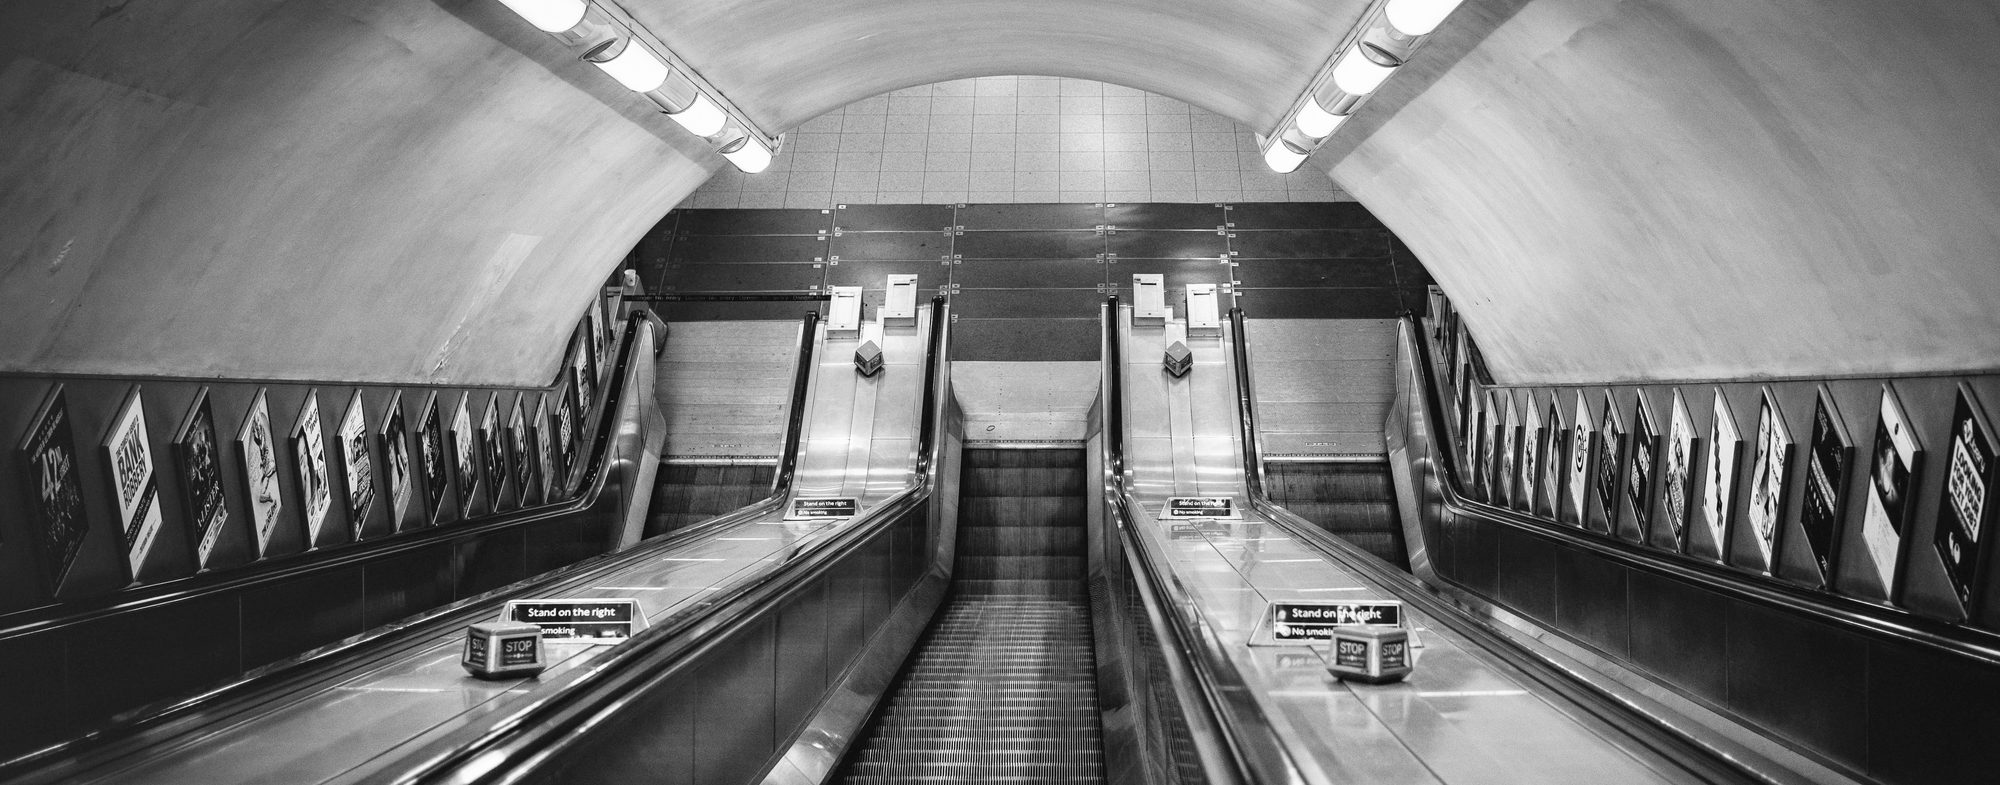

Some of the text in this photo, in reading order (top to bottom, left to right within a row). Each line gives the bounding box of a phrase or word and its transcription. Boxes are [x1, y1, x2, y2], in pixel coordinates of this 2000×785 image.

[117, 422, 144, 487] BANK
[1956, 445, 1982, 502] LOOKING
[122, 454, 147, 510] ROBBERY
[1953, 460, 1964, 488] FOR
[1964, 484, 1979, 517] YOUR
[1951, 476, 1963, 505] NEXT
[1963, 502, 1976, 532] JOB?
[528, 608, 556, 617] Stand
[573, 608, 590, 616] the
[592, 607, 616, 618] right
[1292, 608, 1320, 618] Stand
[1323, 610, 1336, 618] on
[541, 627, 575, 636] smoking
[1292, 628, 1304, 636] No
[506, 640, 532, 652] STOP
[1340, 642, 1365, 655] STOP
[1382, 644, 1402, 656] STOP
